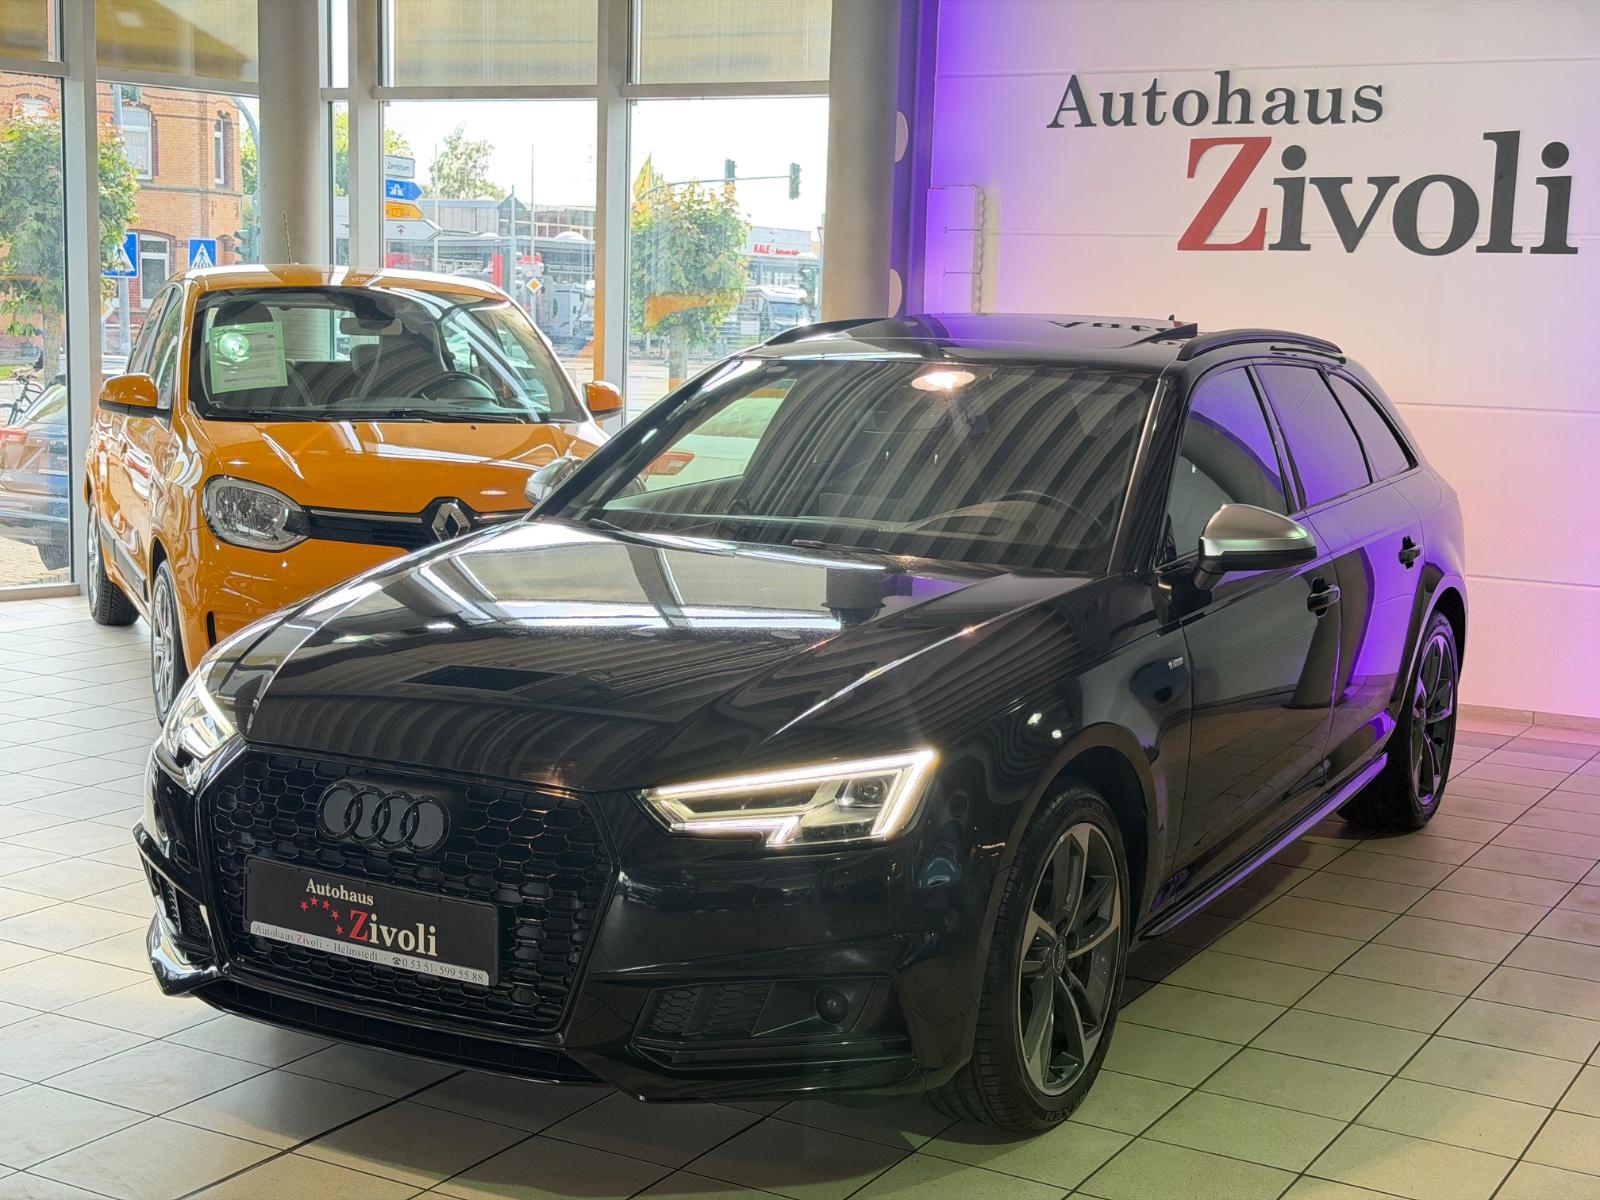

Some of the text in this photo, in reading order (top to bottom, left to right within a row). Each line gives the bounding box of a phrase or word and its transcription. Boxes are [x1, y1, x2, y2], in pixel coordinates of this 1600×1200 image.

[1047, 70, 1383, 128] Autohaus
[1177, 130, 1578, 256] Zivoli
[306, 878, 374, 906] Autohaus
[255, 926, 294, 942] Autohaus
[296, 935, 323, 949] Zivoli
[334, 942, 378, 961] Helmstedt
[349, 908, 437, 957] Zivoli
